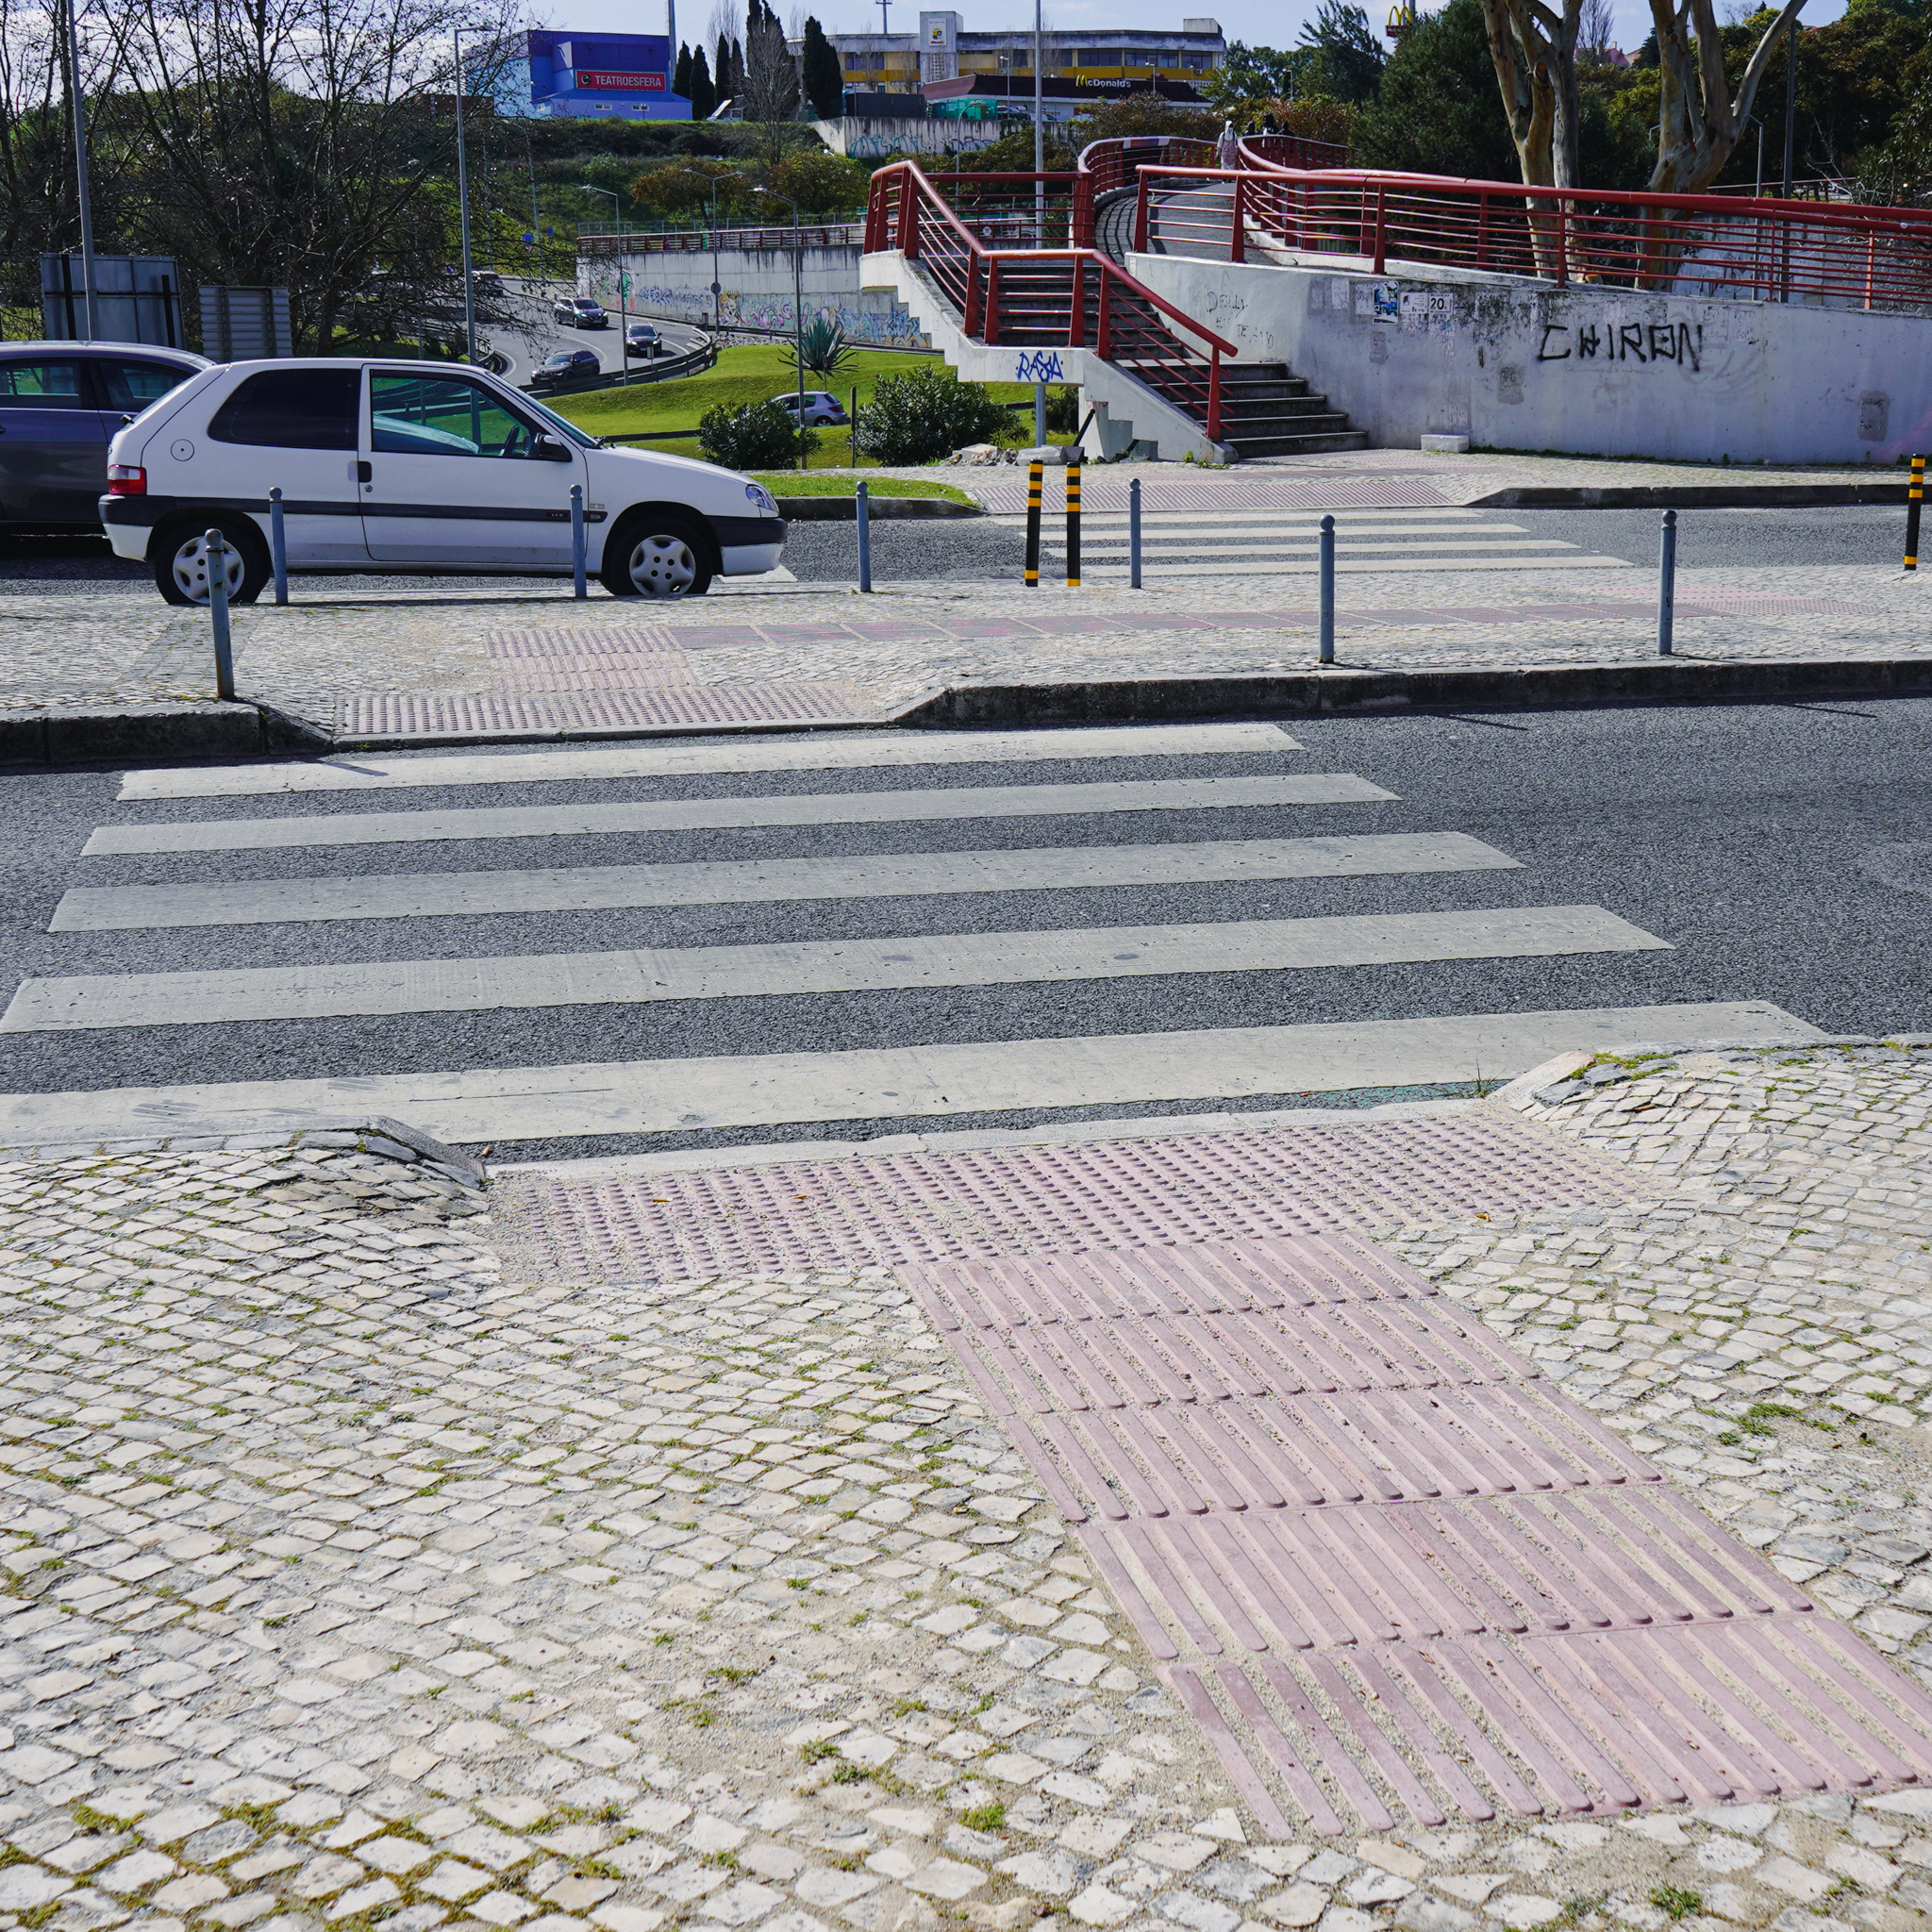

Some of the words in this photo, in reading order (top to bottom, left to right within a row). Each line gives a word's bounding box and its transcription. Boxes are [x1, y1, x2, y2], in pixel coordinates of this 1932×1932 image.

[595, 75, 661, 87] TEATROESFERA
[1075, 75, 1131, 88] McDonald's
[1538, 322, 1702, 373] CHIRON
